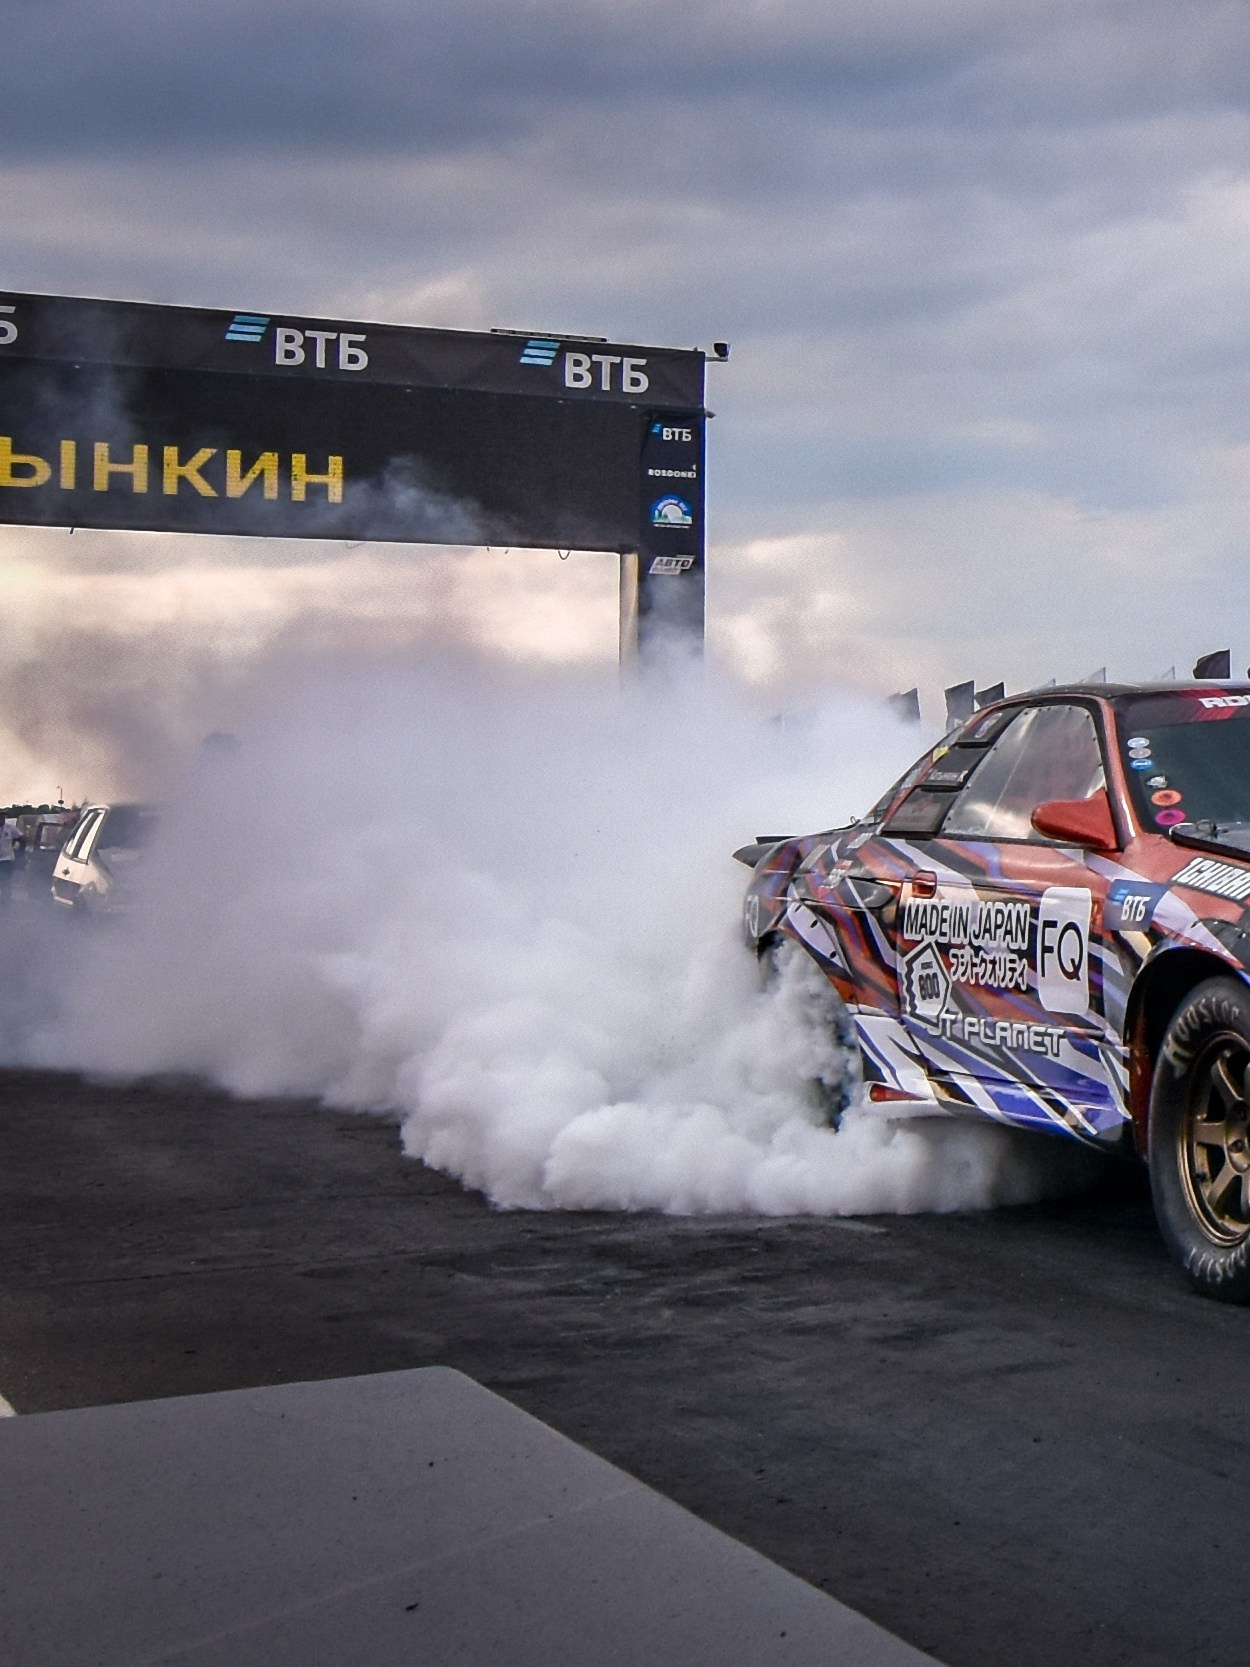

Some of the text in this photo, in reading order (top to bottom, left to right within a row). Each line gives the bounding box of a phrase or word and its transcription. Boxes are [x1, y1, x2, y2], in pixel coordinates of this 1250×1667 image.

[274, 327, 369, 371] ВТБ
[564, 352, 649, 394] ВТБ
[662, 427, 692, 442] ВТБ
[0, 436, 343, 503] ЫНКИН
[904, 901, 1029, 944] MADE IN JAPAN
[1122, 894, 1151, 922] ВТБ
[1040, 919, 1082, 982] FQ
[917, 972, 941, 1001] 800
[964, 1016, 1065, 1054] PLANET
